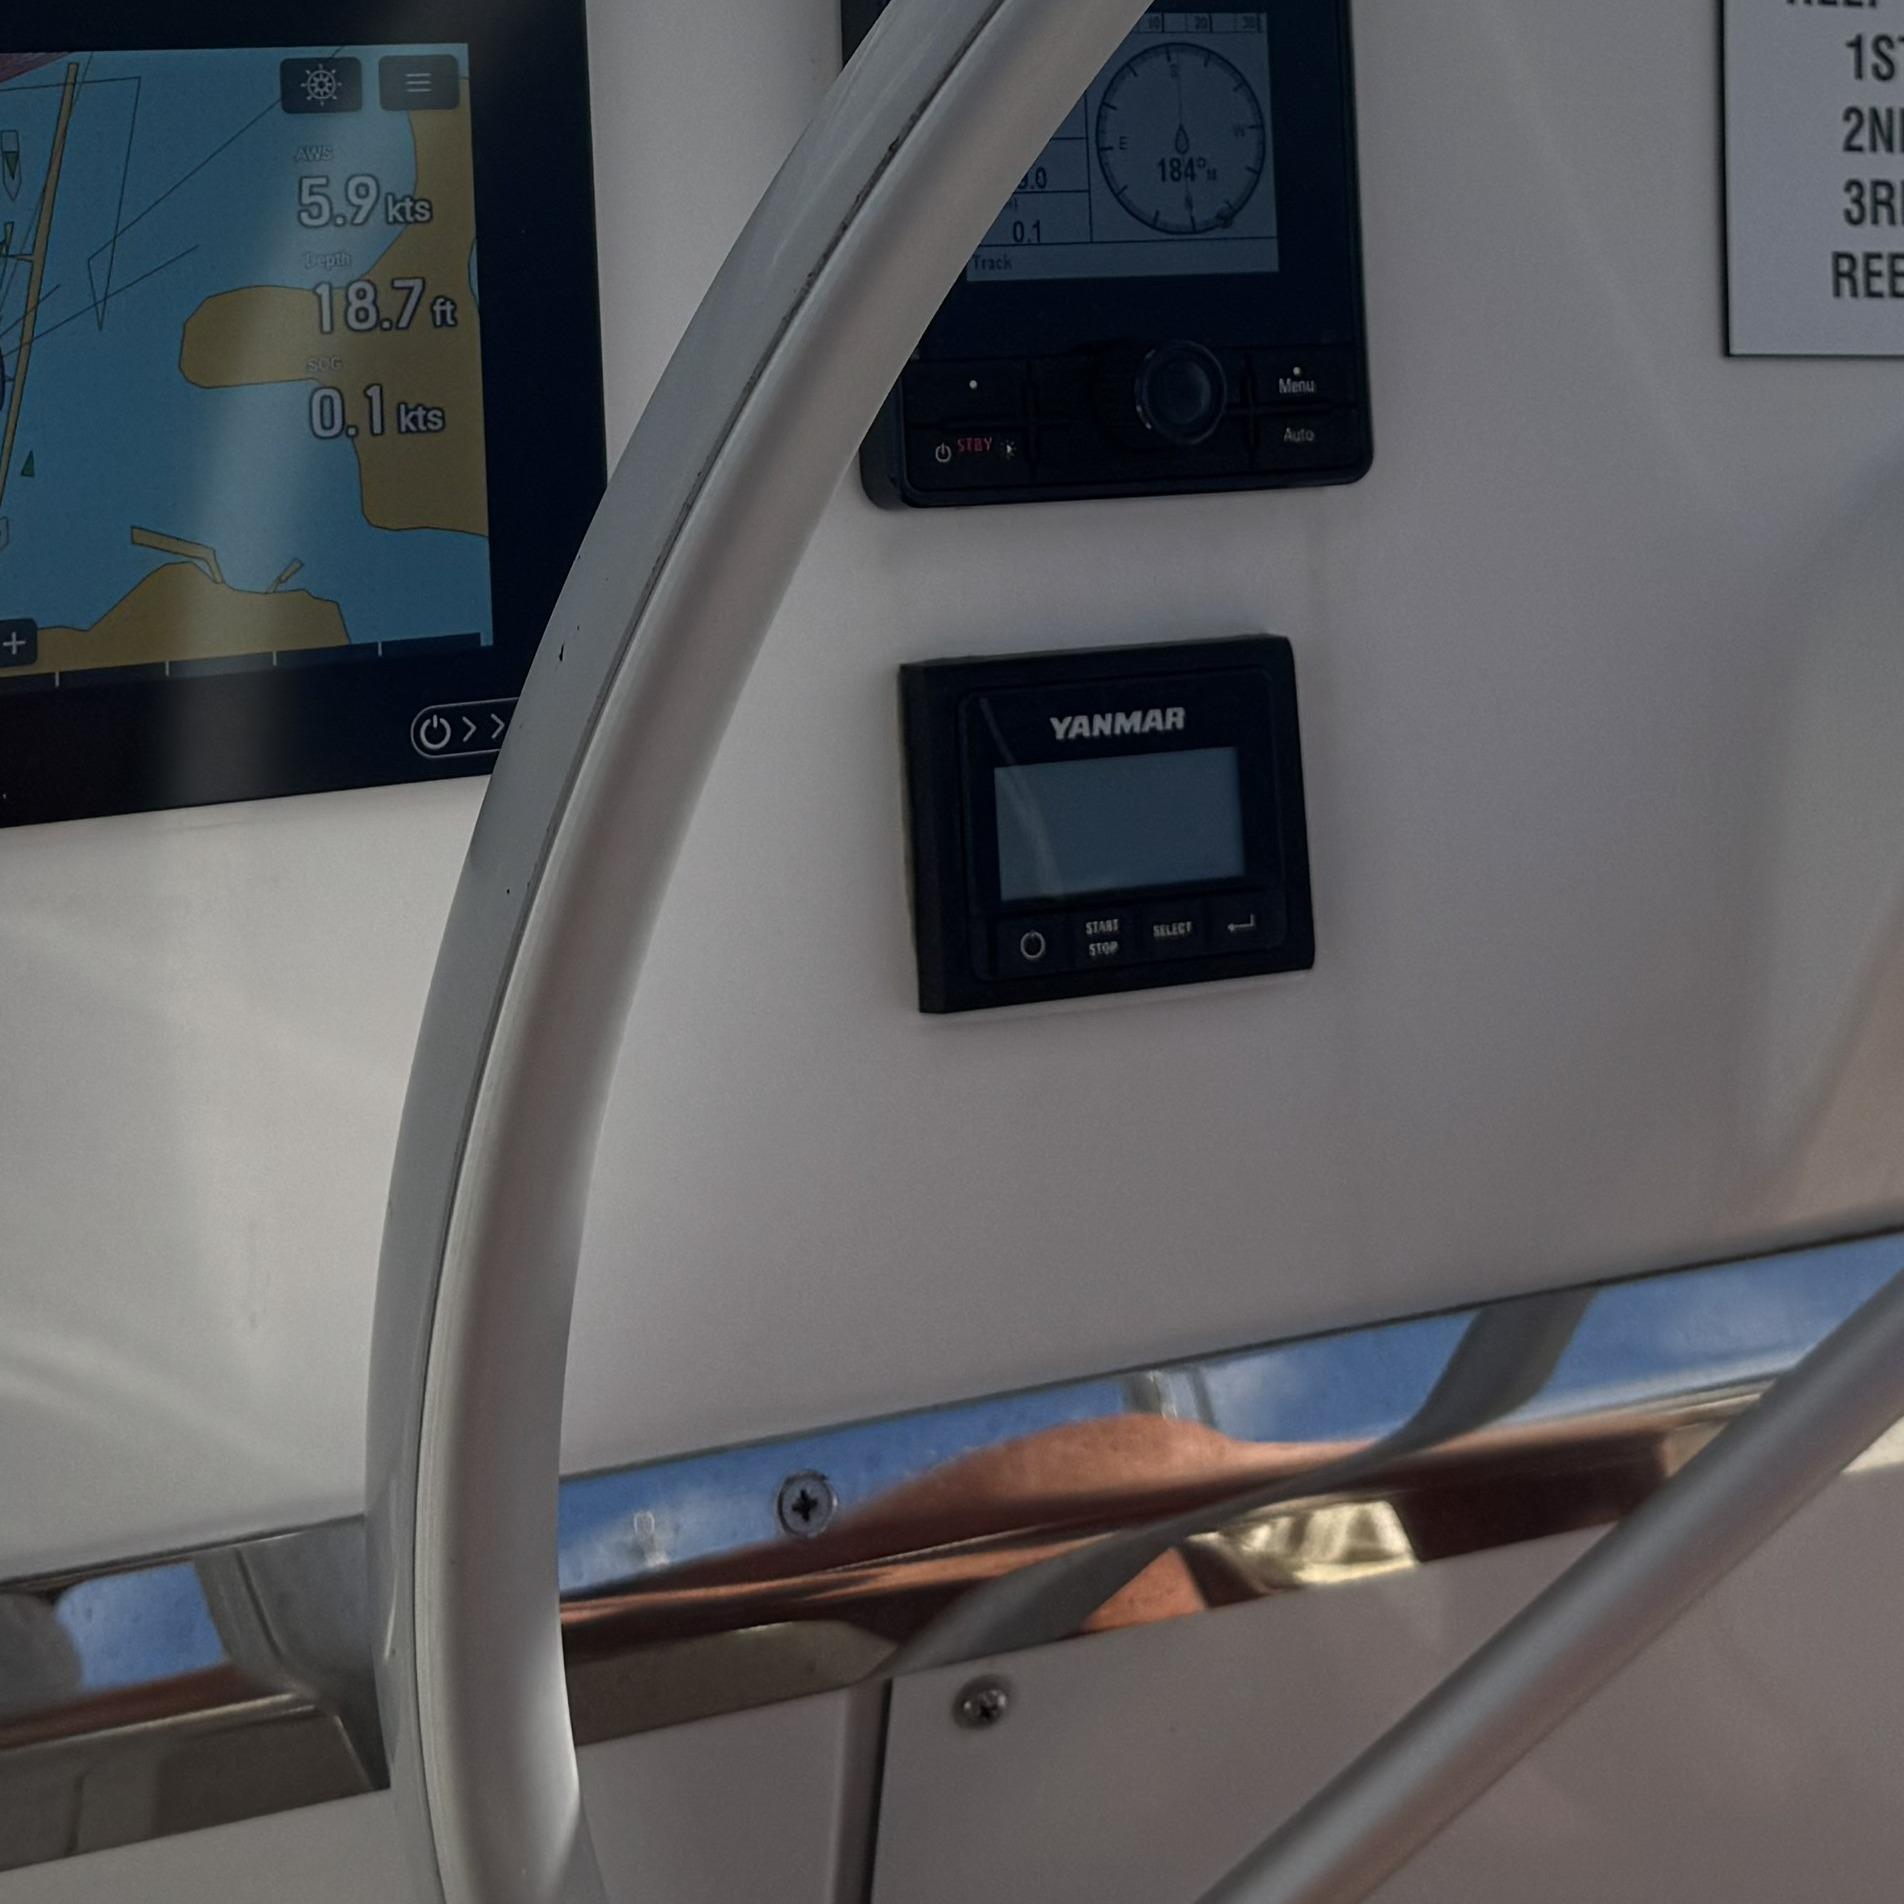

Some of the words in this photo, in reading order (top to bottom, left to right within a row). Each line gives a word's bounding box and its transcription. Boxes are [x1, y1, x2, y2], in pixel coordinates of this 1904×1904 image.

[296, 147, 334, 161] AWS
[299, 175, 380, 228] 5.9
[387, 194, 433, 224] kts
[1012, 220, 1041, 244] 0.1
[304, 252, 352, 270] Depth
[973, 255, 1013, 271] Track
[314, 279, 426, 334] 18.7
[431, 297, 457, 327] ft
[1279, 378, 1315, 395] Menu
[310, 384, 385, 438] 0.1
[399, 402, 444, 433] kts
[956, 435, 993, 453] STBY
[1284, 427, 1315, 443] Auto
[1050, 706, 1186, 741] YANMAR
[1085, 918, 1120, 936] START
[1152, 921, 1193, 939] SELECT
[1089, 940, 1119, 958] STOP
